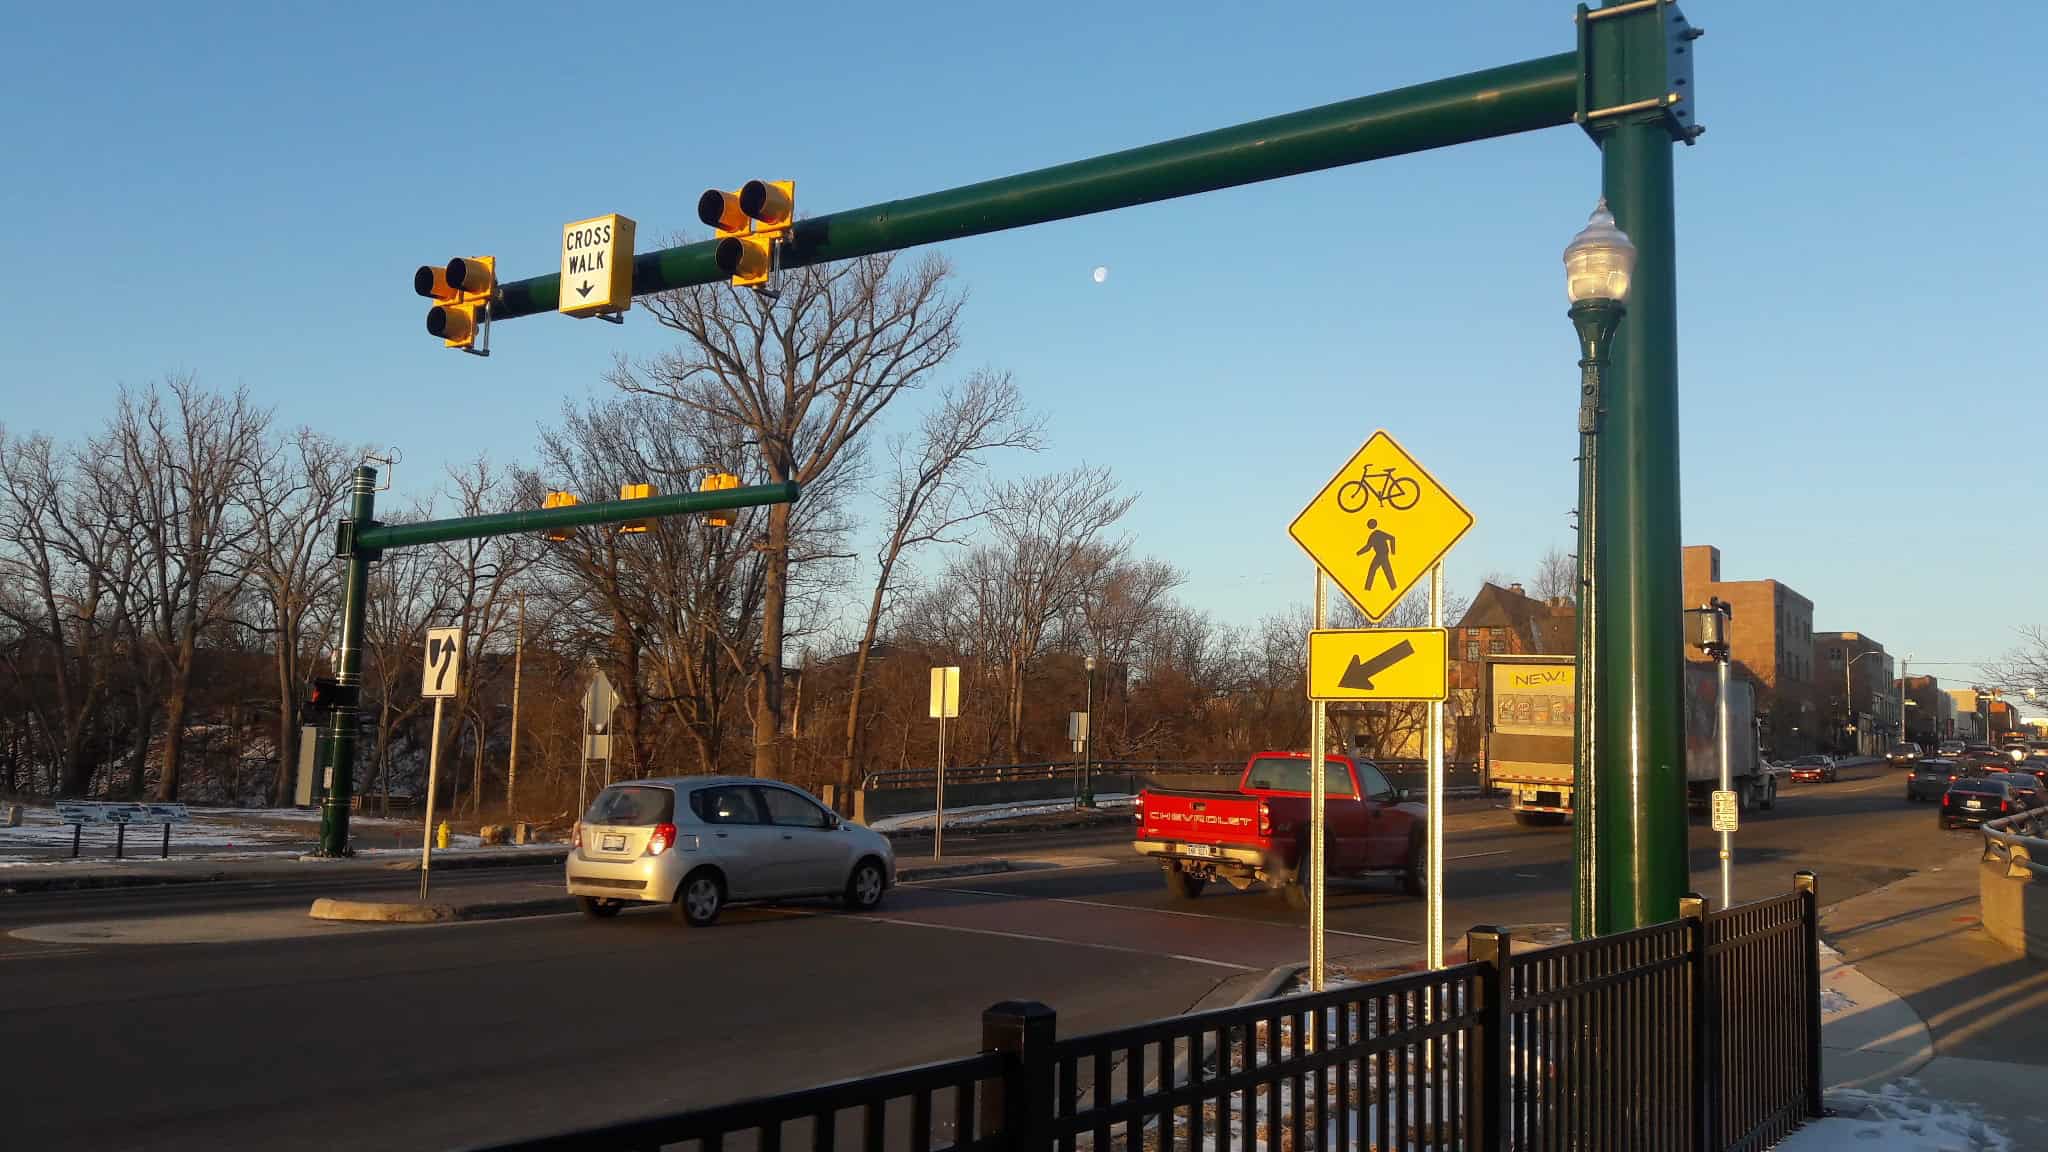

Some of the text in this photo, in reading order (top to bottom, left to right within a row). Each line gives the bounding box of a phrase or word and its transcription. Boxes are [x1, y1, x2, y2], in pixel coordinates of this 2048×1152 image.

[567, 225, 610, 250] CROSS
[569, 250, 604, 275] WALK
[1515, 671, 1566, 686] NEW!
[1149, 811, 1253, 827] CHEVROLET
